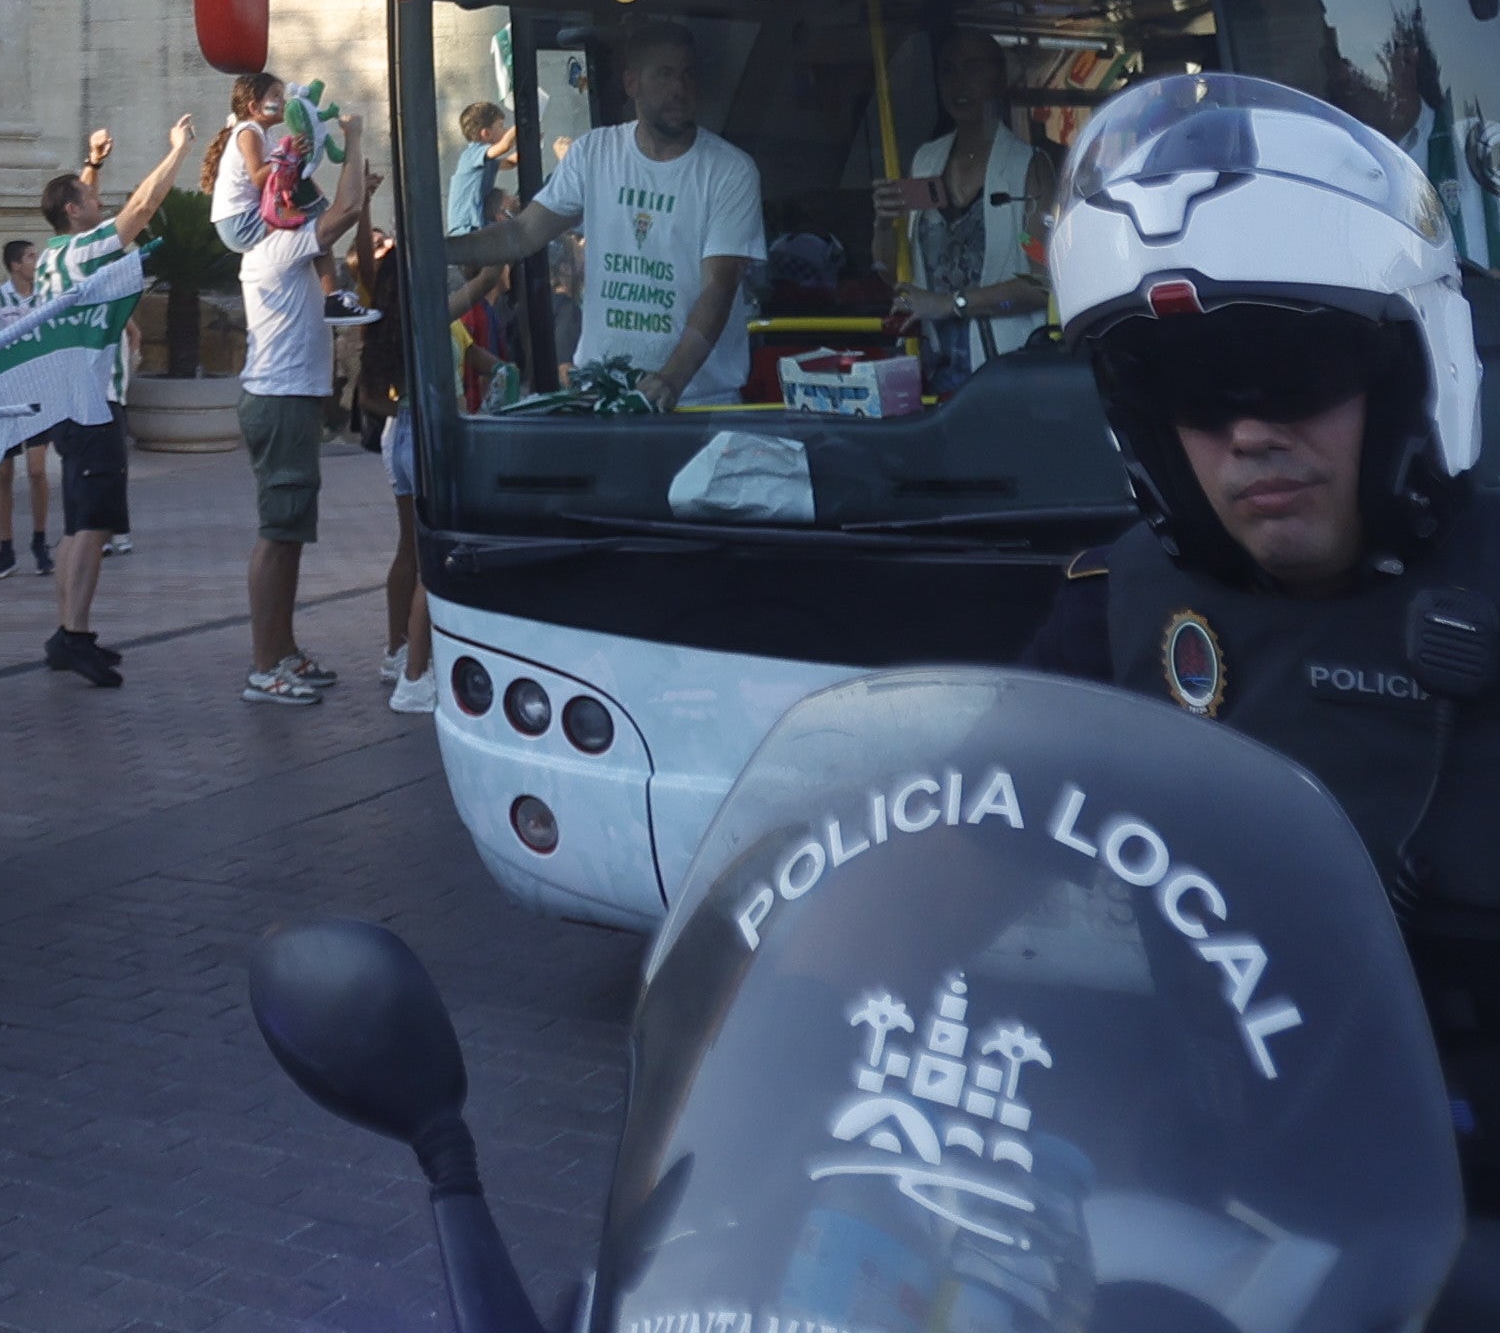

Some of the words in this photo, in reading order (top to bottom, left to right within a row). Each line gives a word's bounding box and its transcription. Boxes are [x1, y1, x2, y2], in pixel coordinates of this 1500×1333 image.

[604, 252, 675, 282] SENTIMOS
[606, 308, 672, 334] CREIMOS
[1310, 665, 1432, 700] POLICI
[736, 772, 1025, 951] POLICIA
[1048, 785, 1303, 1080] LOCAL
